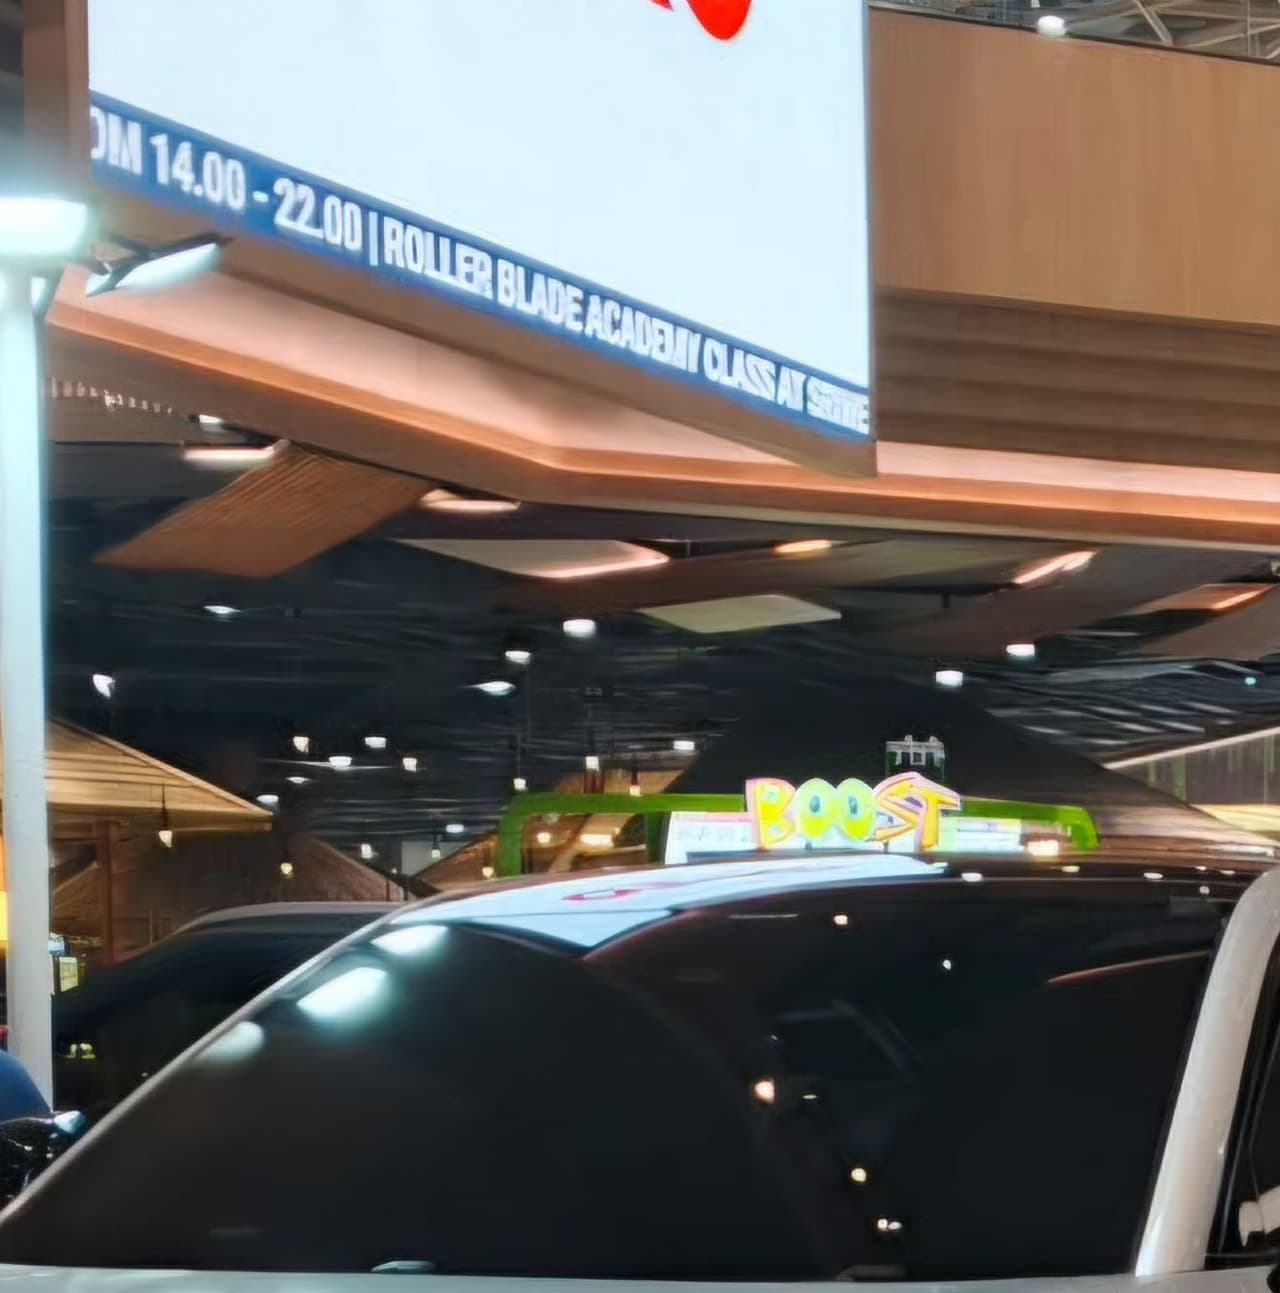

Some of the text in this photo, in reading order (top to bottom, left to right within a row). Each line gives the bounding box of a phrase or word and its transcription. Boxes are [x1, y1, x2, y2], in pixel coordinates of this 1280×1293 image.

[150, 133, 246, 211] 14.00
[273, 177, 363, 251] 22.00
[383, 216, 493, 300] ROLLER
[497, 258, 585, 332] BLADE
[584, 294, 702, 373] ACADEMY
[703, 337, 776, 401] CLASS
[745, 771, 961, 853] BOOST
